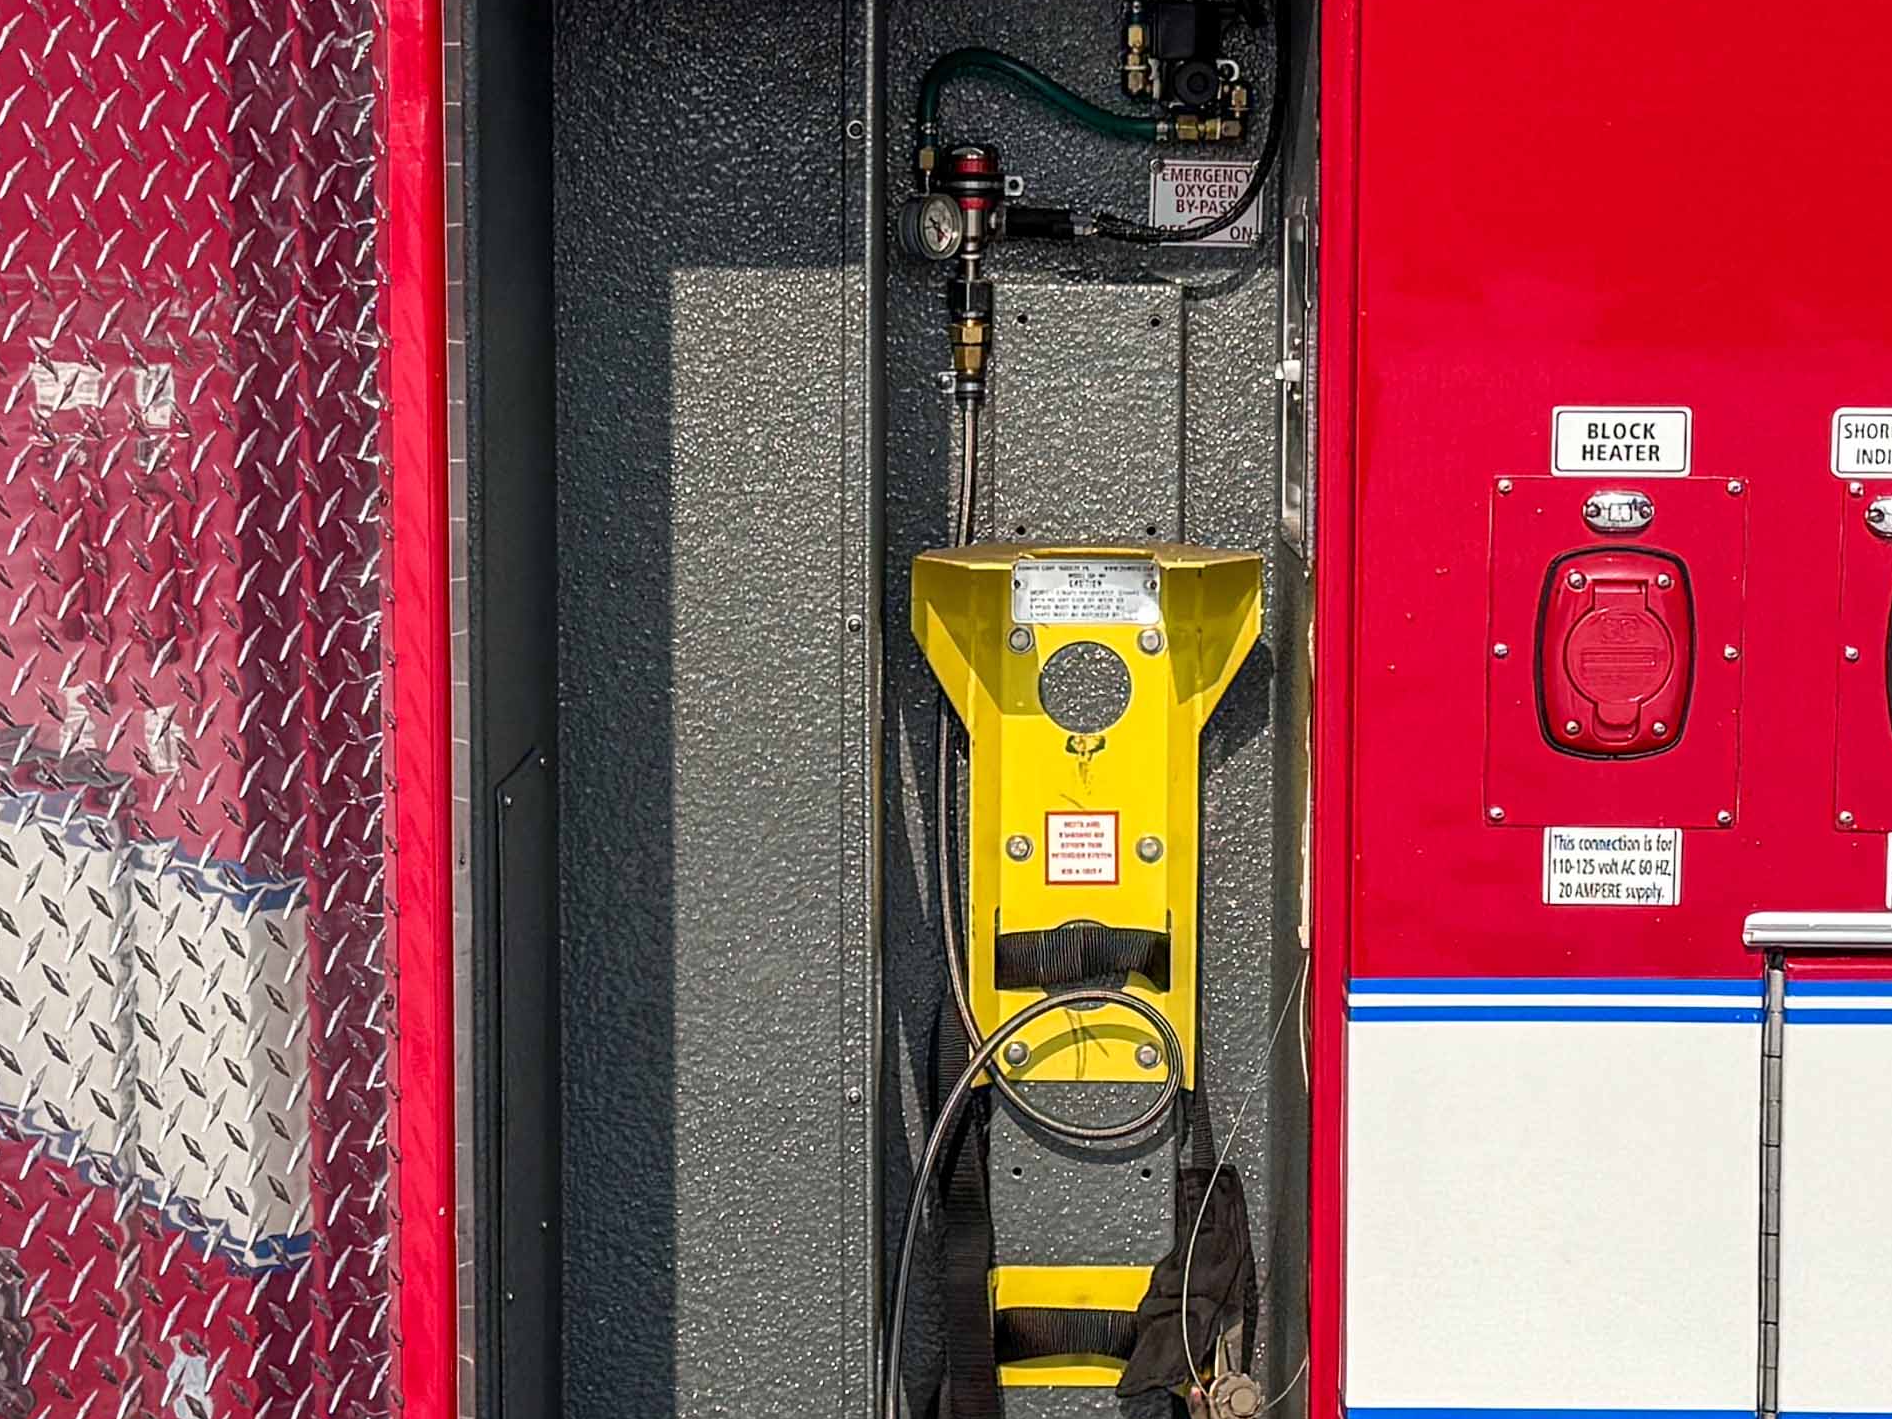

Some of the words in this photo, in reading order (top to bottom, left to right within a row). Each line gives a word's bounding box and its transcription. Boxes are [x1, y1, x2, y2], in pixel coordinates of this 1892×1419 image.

[1162, 167, 1252, 183] EMERGENCY
[1174, 183, 1239, 199] OXYGEN
[1229, 225, 1253, 241] ON
[1587, 422, 1656, 440] BLOCK
[1581, 444, 1660, 462] HEATER
[1554, 834, 1575, 851] This
[1579, 834, 1641, 851] connection
[1644, 834, 1653, 851] is
[1656, 833, 1673, 852] for
[1553, 858, 1595, 875] 110-125
[1598, 857, 1618, 875] volt
[1621, 859, 1636, 875] AC
[1638, 859, 1653, 875] 60
[1558, 882, 1573, 898] 20
[1575, 882, 1622, 899] AMPERE
